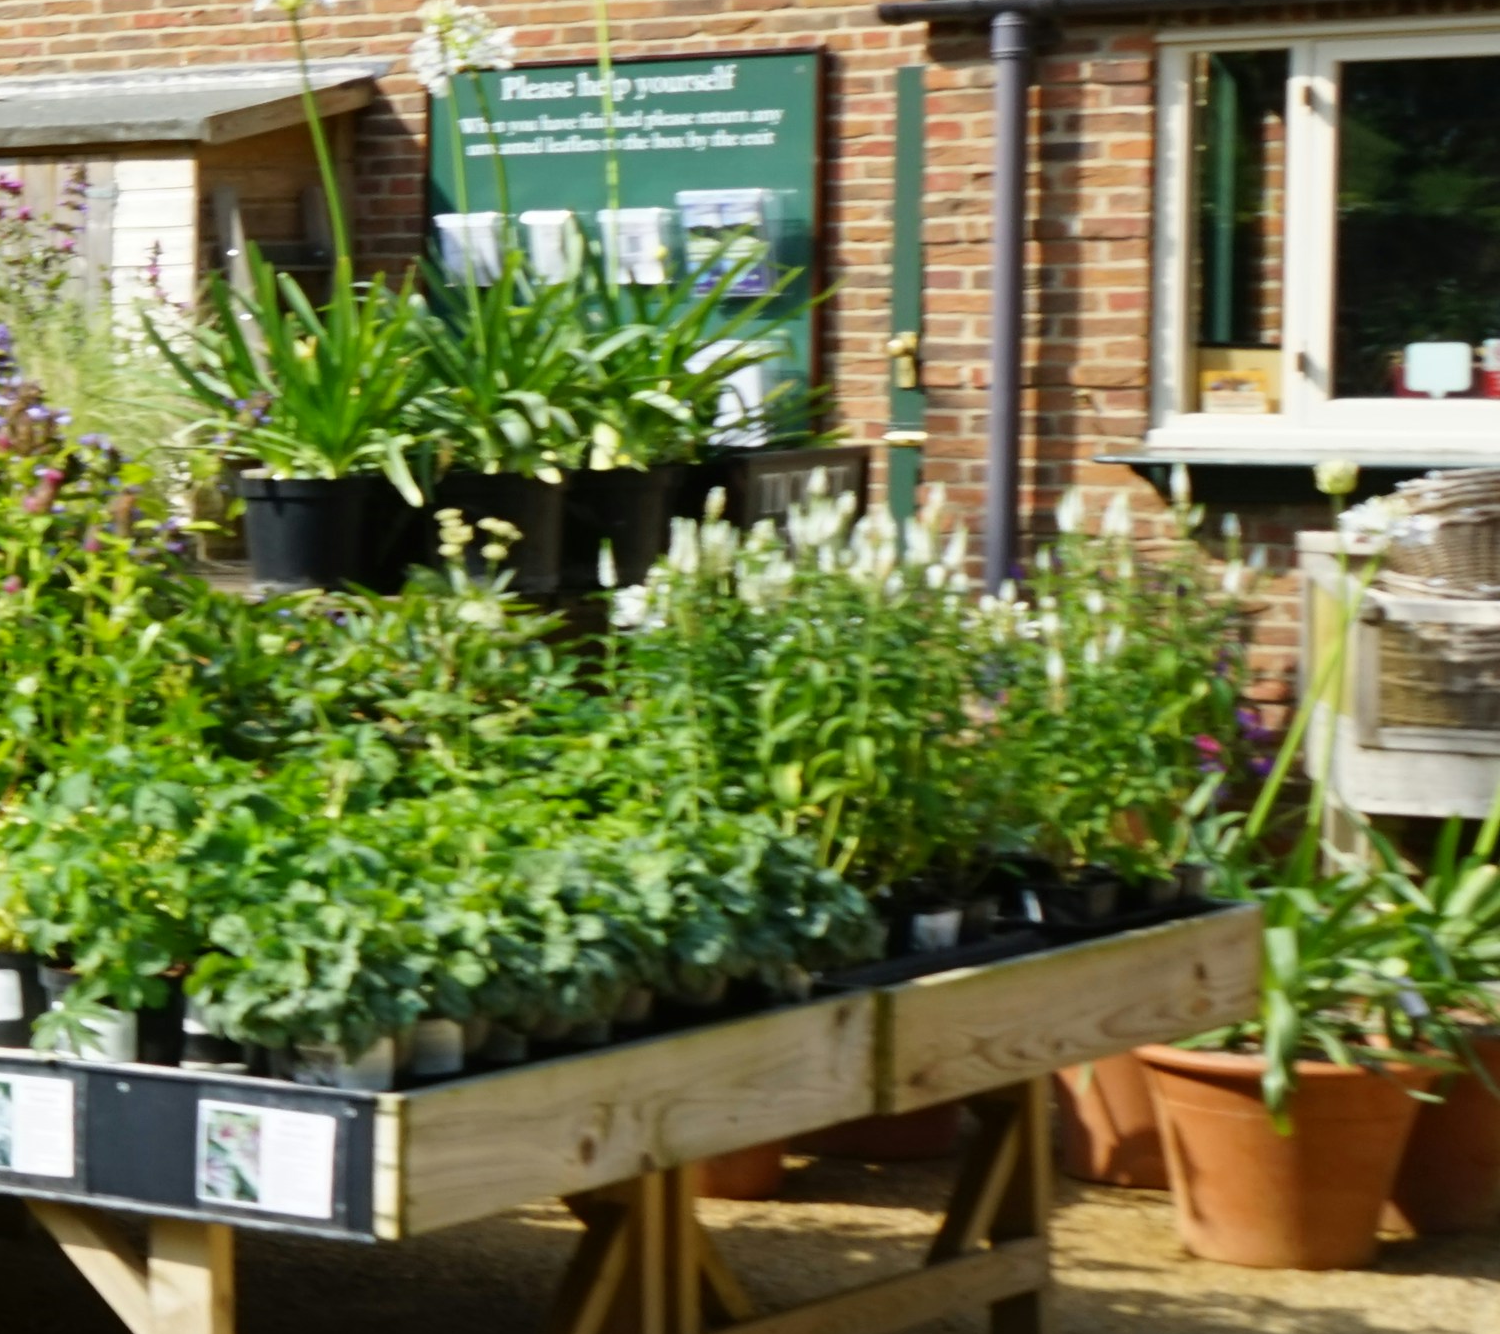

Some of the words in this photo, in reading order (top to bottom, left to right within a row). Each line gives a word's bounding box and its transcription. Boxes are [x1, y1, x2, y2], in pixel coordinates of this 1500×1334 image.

[500, 75, 575, 100] Please
[576, 71, 632, 101] help
[633, 64, 738, 100] yourself
[641, 109, 695, 131] please
[695, 110, 750, 125] return
[621, 133, 650, 150] the
[709, 129, 740, 147] the
